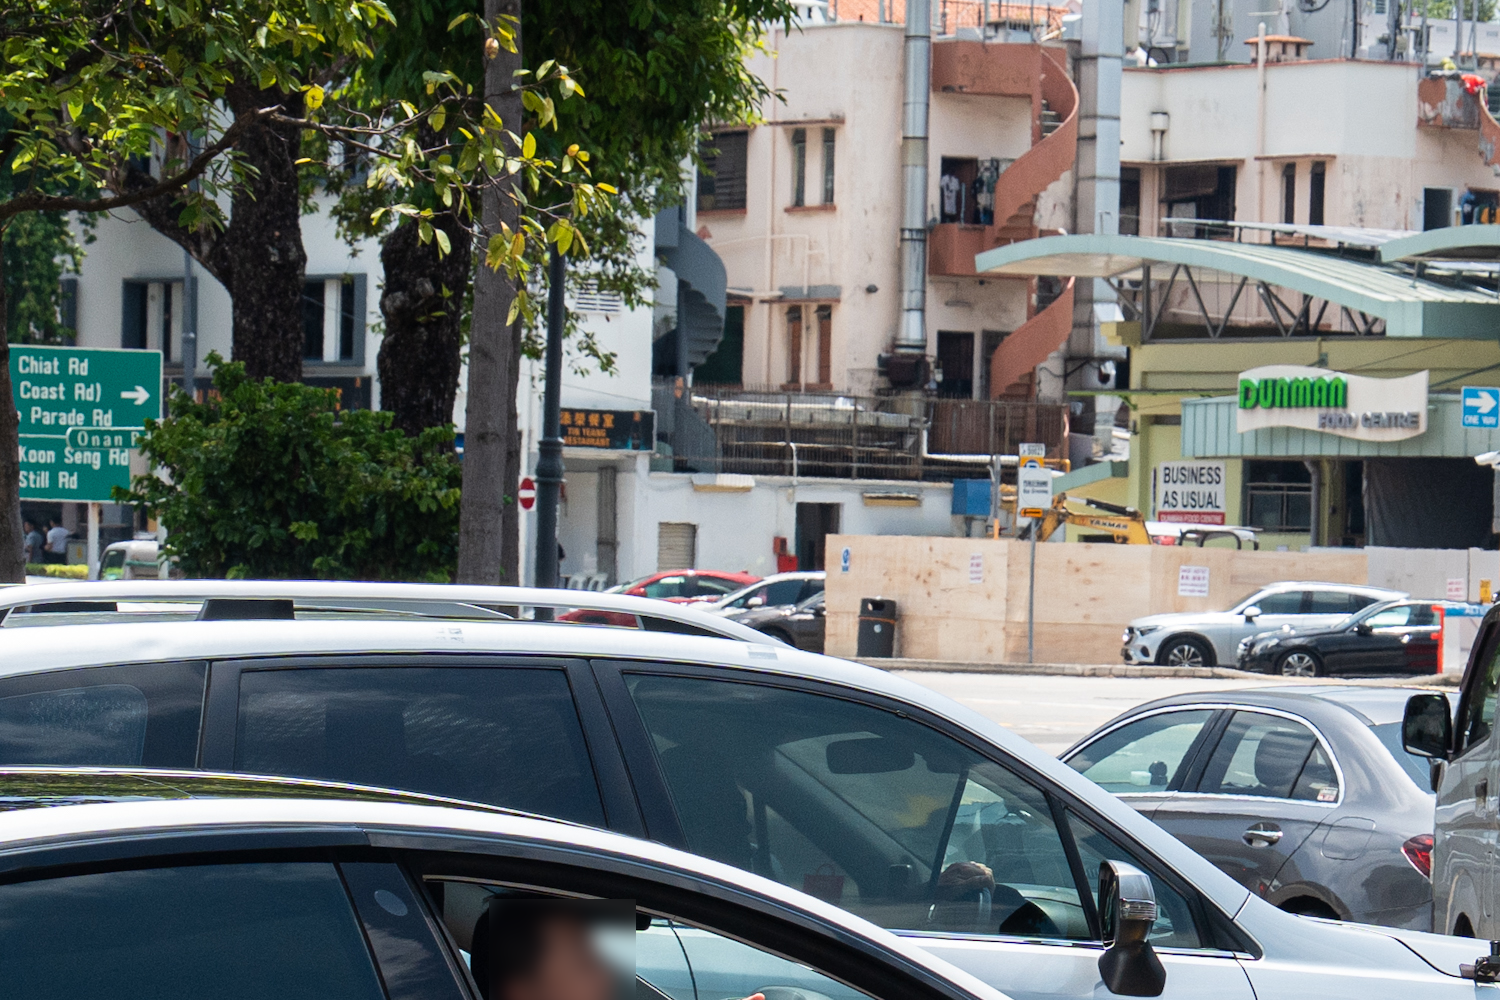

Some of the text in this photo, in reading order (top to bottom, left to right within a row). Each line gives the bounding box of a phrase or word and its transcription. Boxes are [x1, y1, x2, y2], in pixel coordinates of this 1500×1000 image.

[18, 355, 89, 376] Chiat Rd
[20, 380, 102, 402] Coast Rd)
[1238, 376, 1348, 410] DUNMAN
[30, 406, 85, 426] Parade
[92, 409, 113, 427] Rd
[1318, 411, 1420, 430] FOOD CENTRE
[1464, 414, 1497, 425] ONE WAY
[77, 431, 123, 447] Onan
[18, 446, 130, 471] Koon Seng Rd
[19, 471, 78, 490] Still Rd
[1163, 466, 1221, 485] BUSINESS
[1162, 490, 1221, 509] AS USUAL
[1090, 519, 1128, 529] YANMAR
